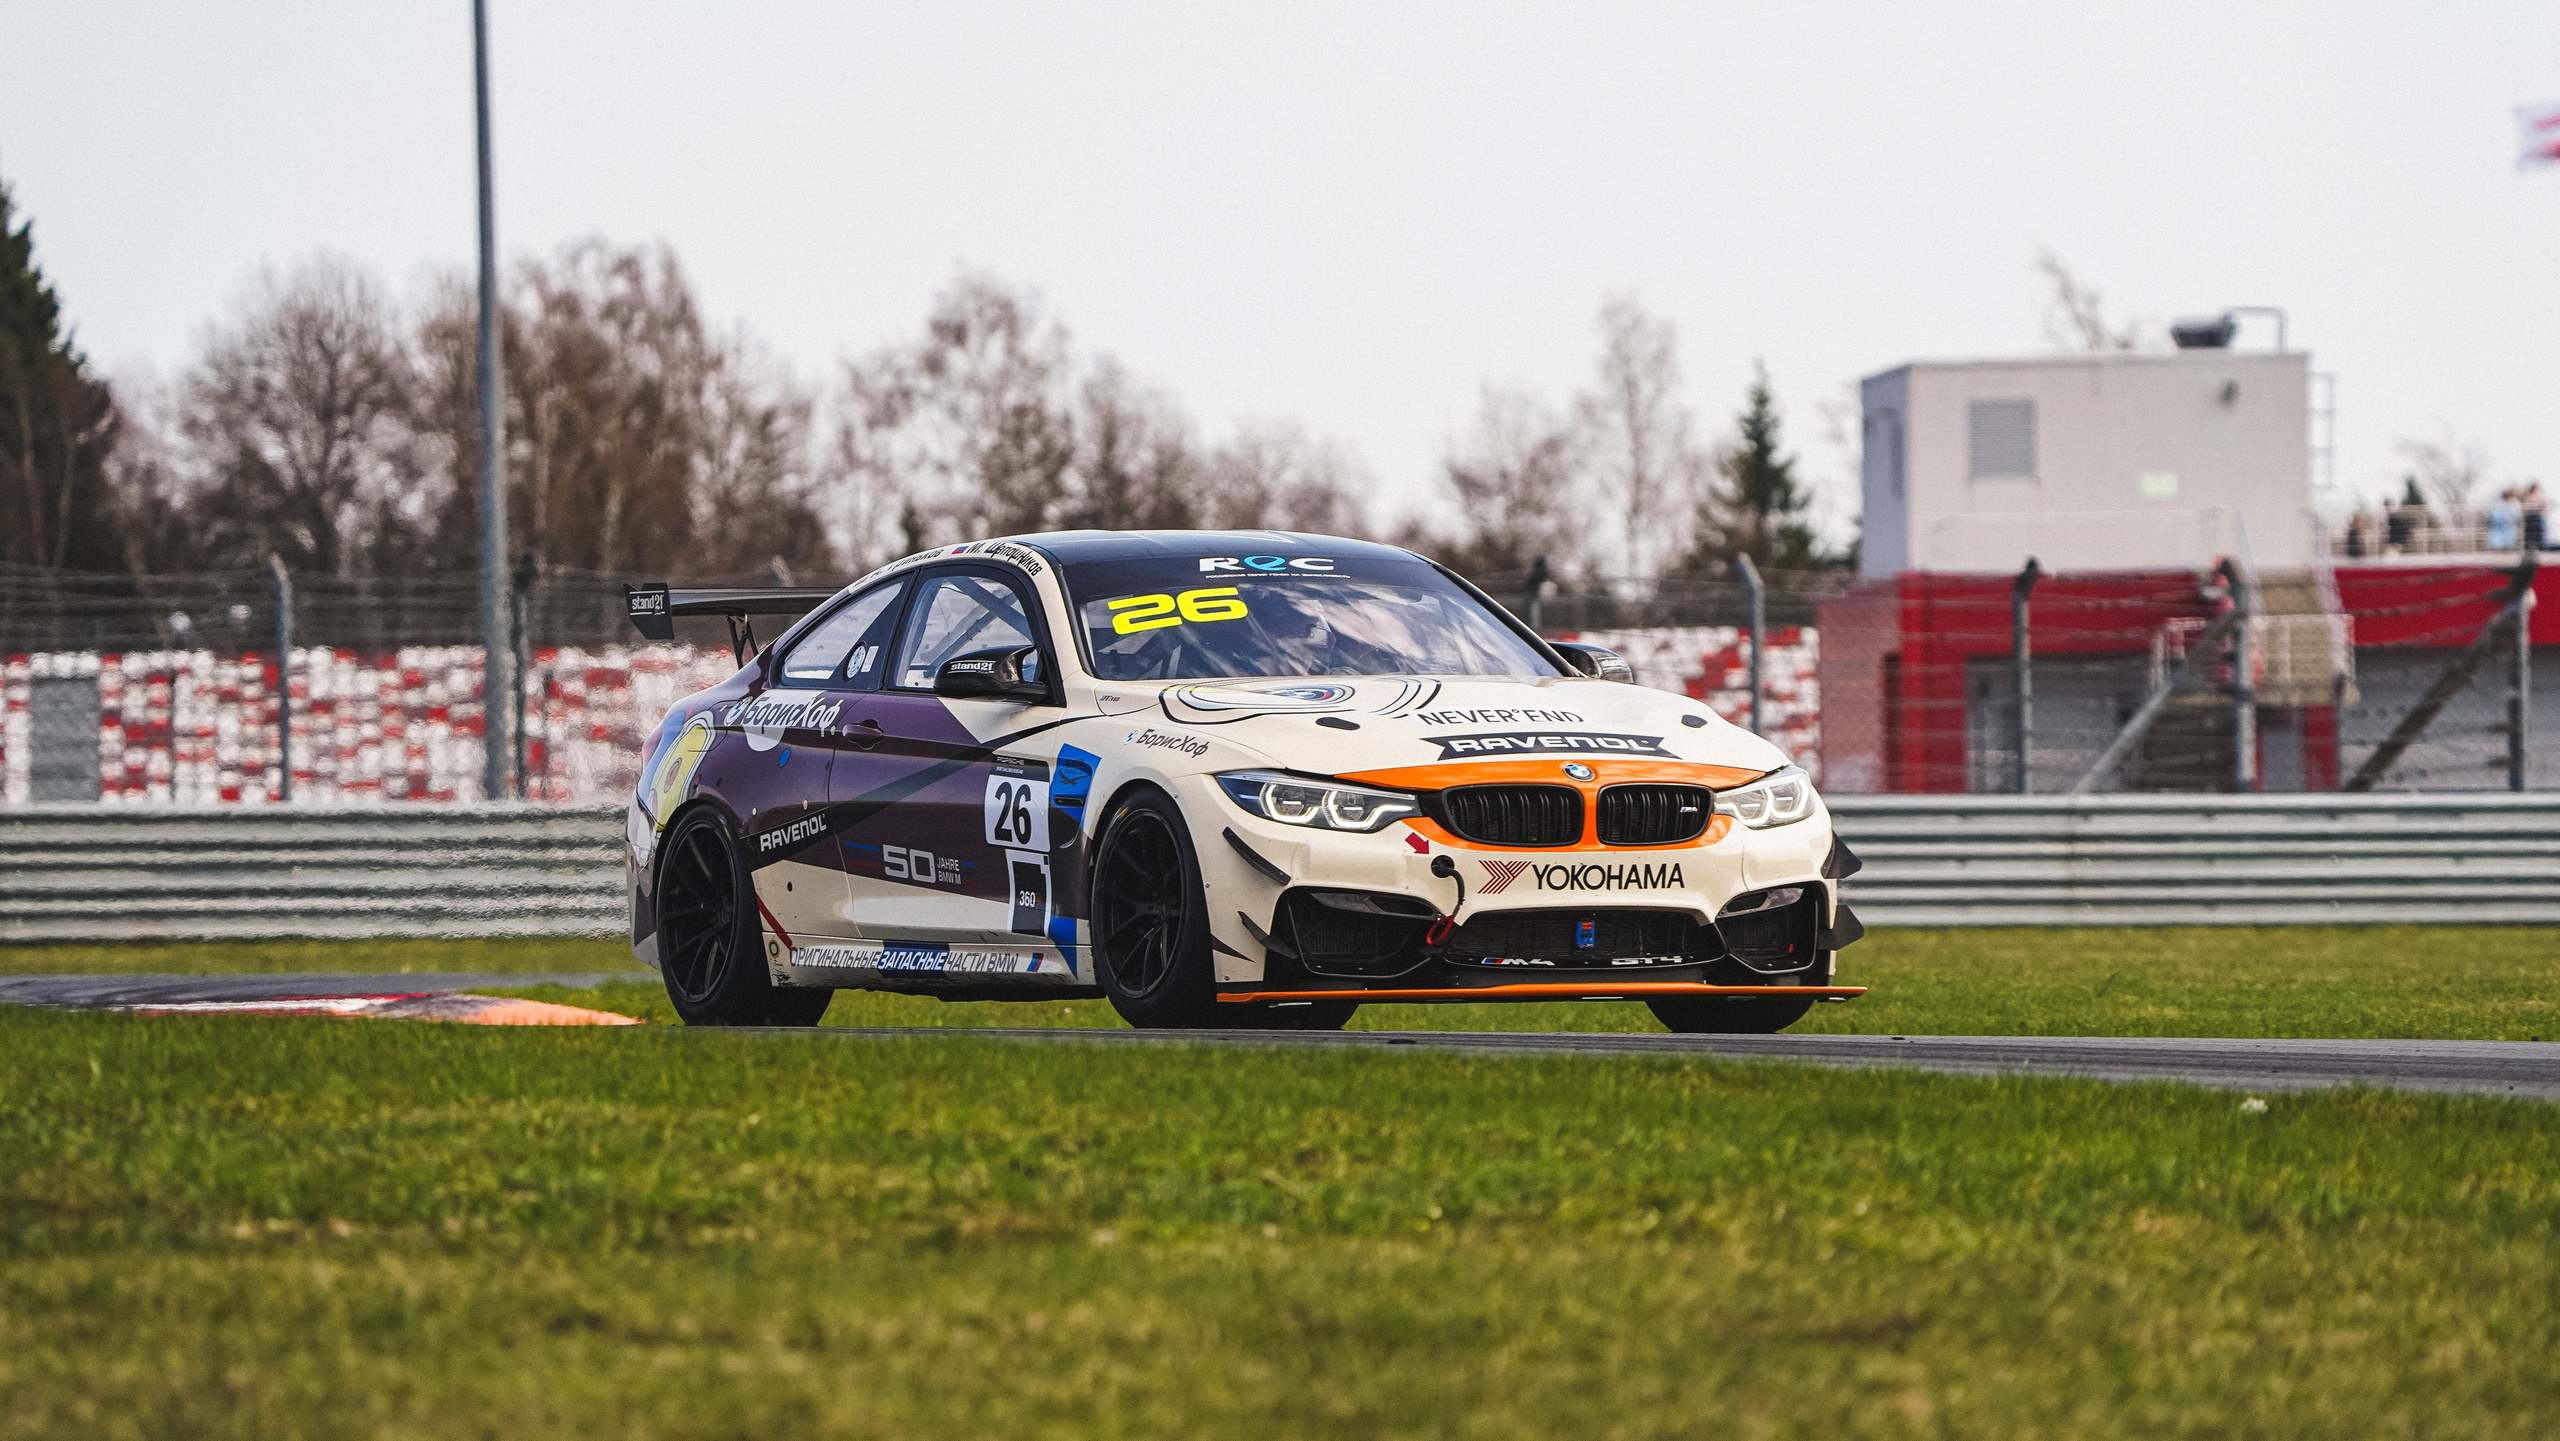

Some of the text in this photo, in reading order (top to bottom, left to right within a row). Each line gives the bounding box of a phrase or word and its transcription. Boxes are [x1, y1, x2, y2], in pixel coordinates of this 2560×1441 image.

[631, 594, 665, 610] stand21
[1107, 587, 1249, 635] 26
[951, 662, 993, 671] stand21
[741, 697, 844, 737] БорисХоф
[1136, 729, 1210, 758] БорисХоф
[1447, 736, 1657, 753] RAVENOL
[994, 781, 1032, 845] 26
[759, 814, 827, 852] RAVENOL
[882, 844, 936, 884] 50
[937, 857, 960, 872] JAHRE
[938, 870, 962, 885] BMW M
[1532, 863, 1685, 891] YOKOHAMA
[1019, 890, 1036, 908] 360
[789, 946, 1019, 972] ОРИГИНАЛЬНЫЕ ЗАПАСНЫЕ ЧАСТИ BMW
